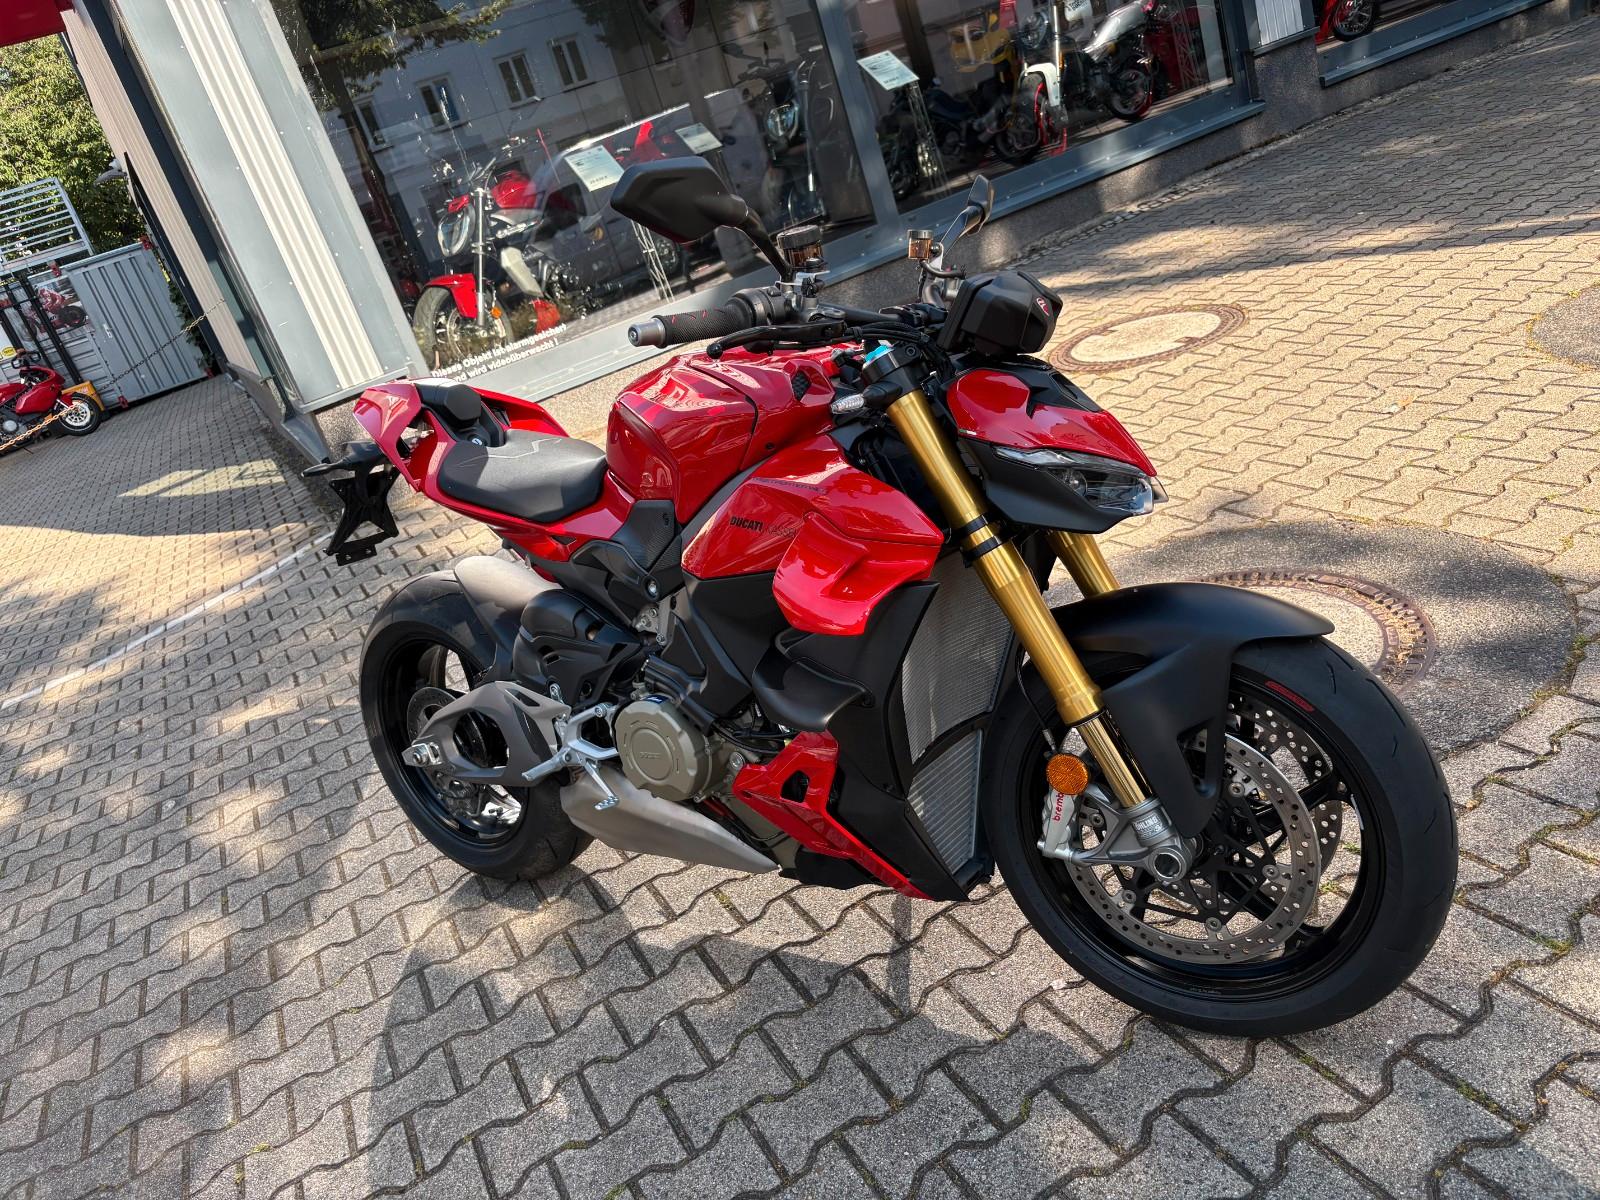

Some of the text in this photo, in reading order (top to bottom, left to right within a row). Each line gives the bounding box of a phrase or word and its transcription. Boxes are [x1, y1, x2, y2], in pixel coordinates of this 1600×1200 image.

[463, 350, 492, 368] Objekt
[505, 322, 567, 353] alarmgesichert
[467, 364, 488, 378] wird
[487, 339, 555, 371] videoüberwacht
[730, 516, 764, 533] DUCATI
[1052, 791, 1065, 821] bremb
